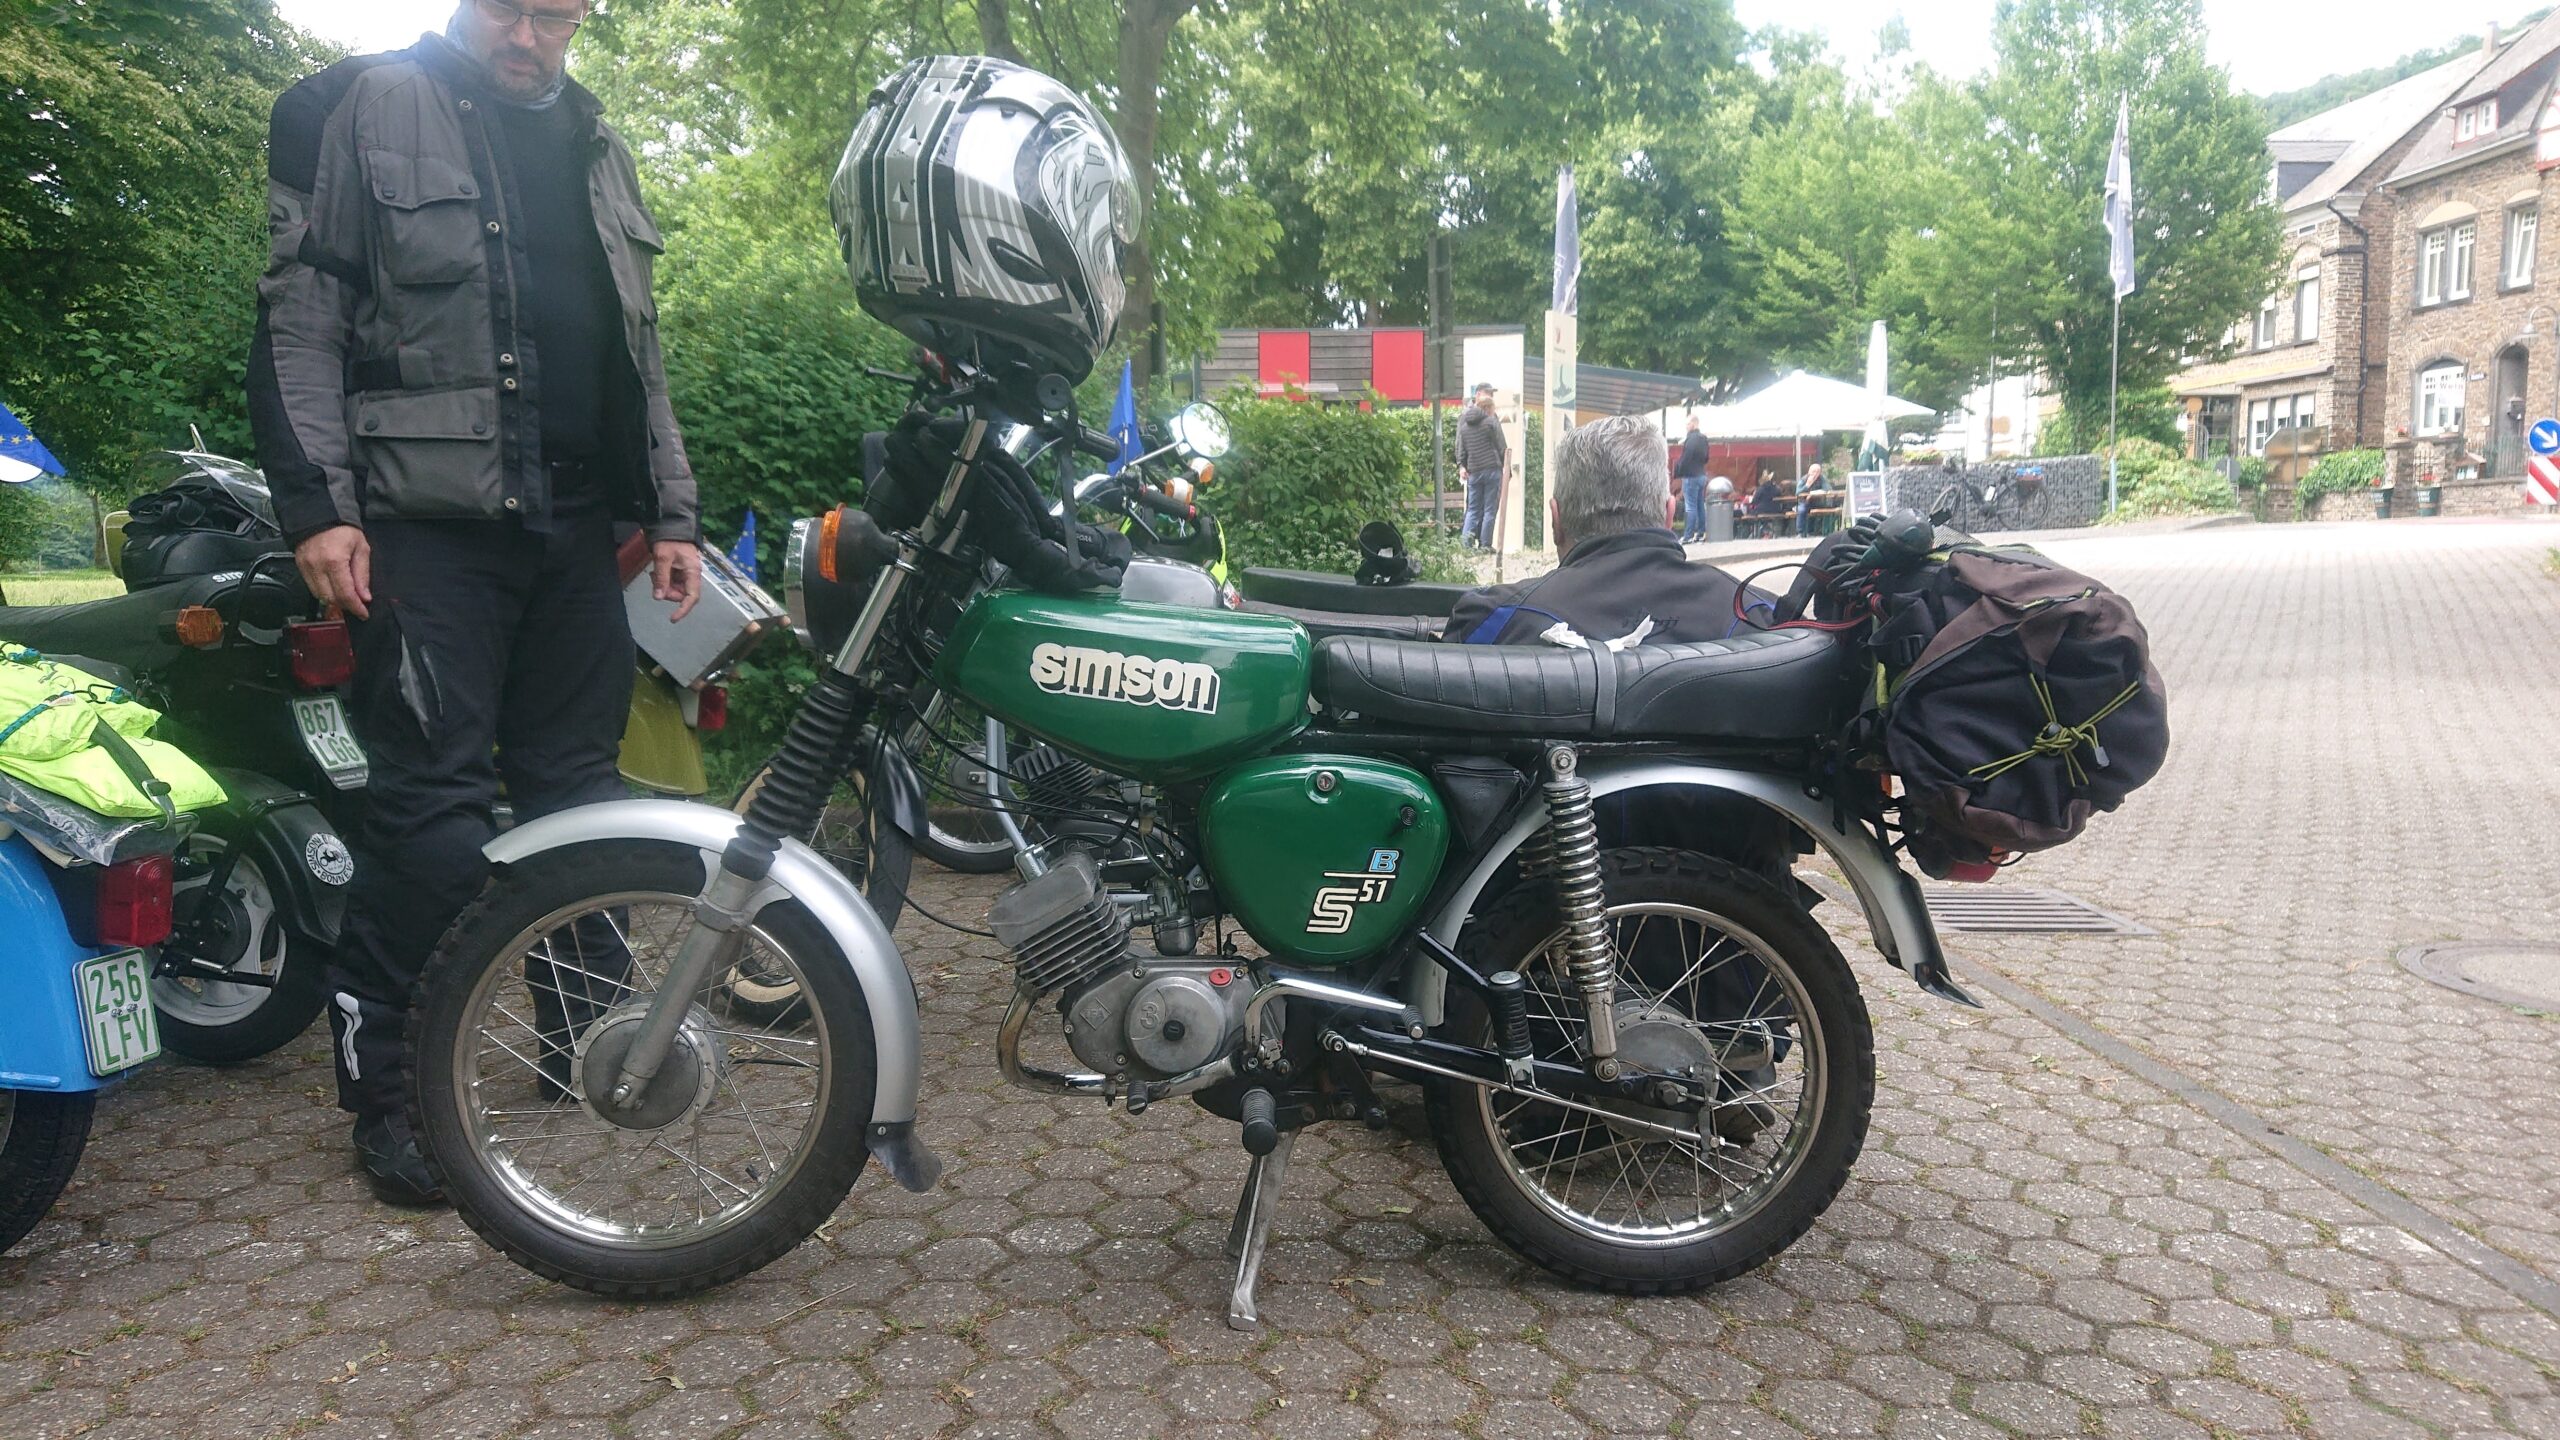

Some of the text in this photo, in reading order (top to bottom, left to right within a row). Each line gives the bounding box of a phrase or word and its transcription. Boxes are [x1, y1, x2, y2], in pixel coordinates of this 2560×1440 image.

[300, 702, 337, 735] 867
[312, 736, 360, 767] LGG
[89, 960, 143, 1015] 256
[99, 1008, 148, 1066] LFV
